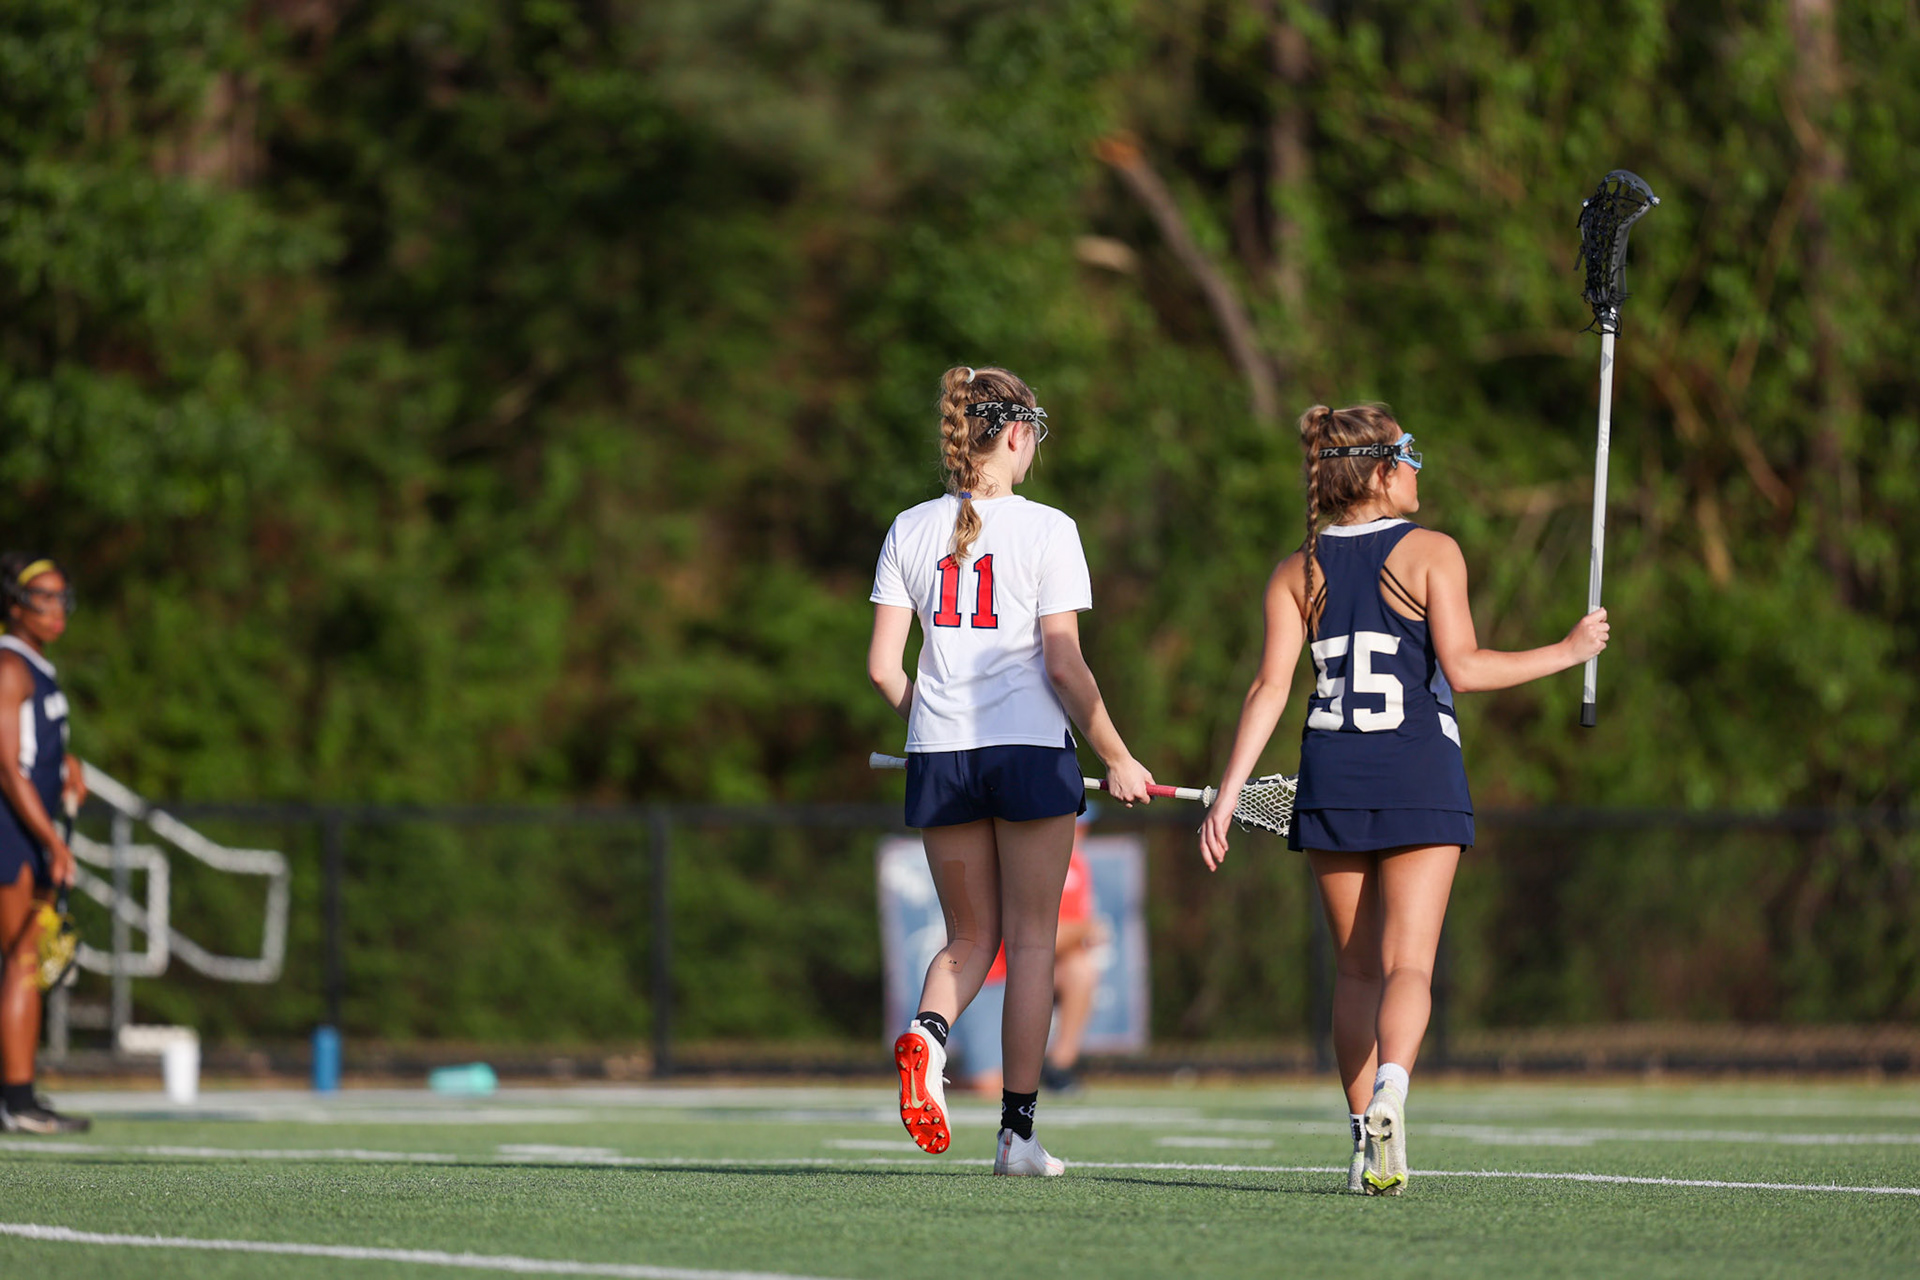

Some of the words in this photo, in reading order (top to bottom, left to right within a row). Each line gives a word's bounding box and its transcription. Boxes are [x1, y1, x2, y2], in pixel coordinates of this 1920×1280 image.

[976, 402, 1003, 411] STX
[934, 554, 998, 629] 11
[1308, 631, 1405, 732] 55
